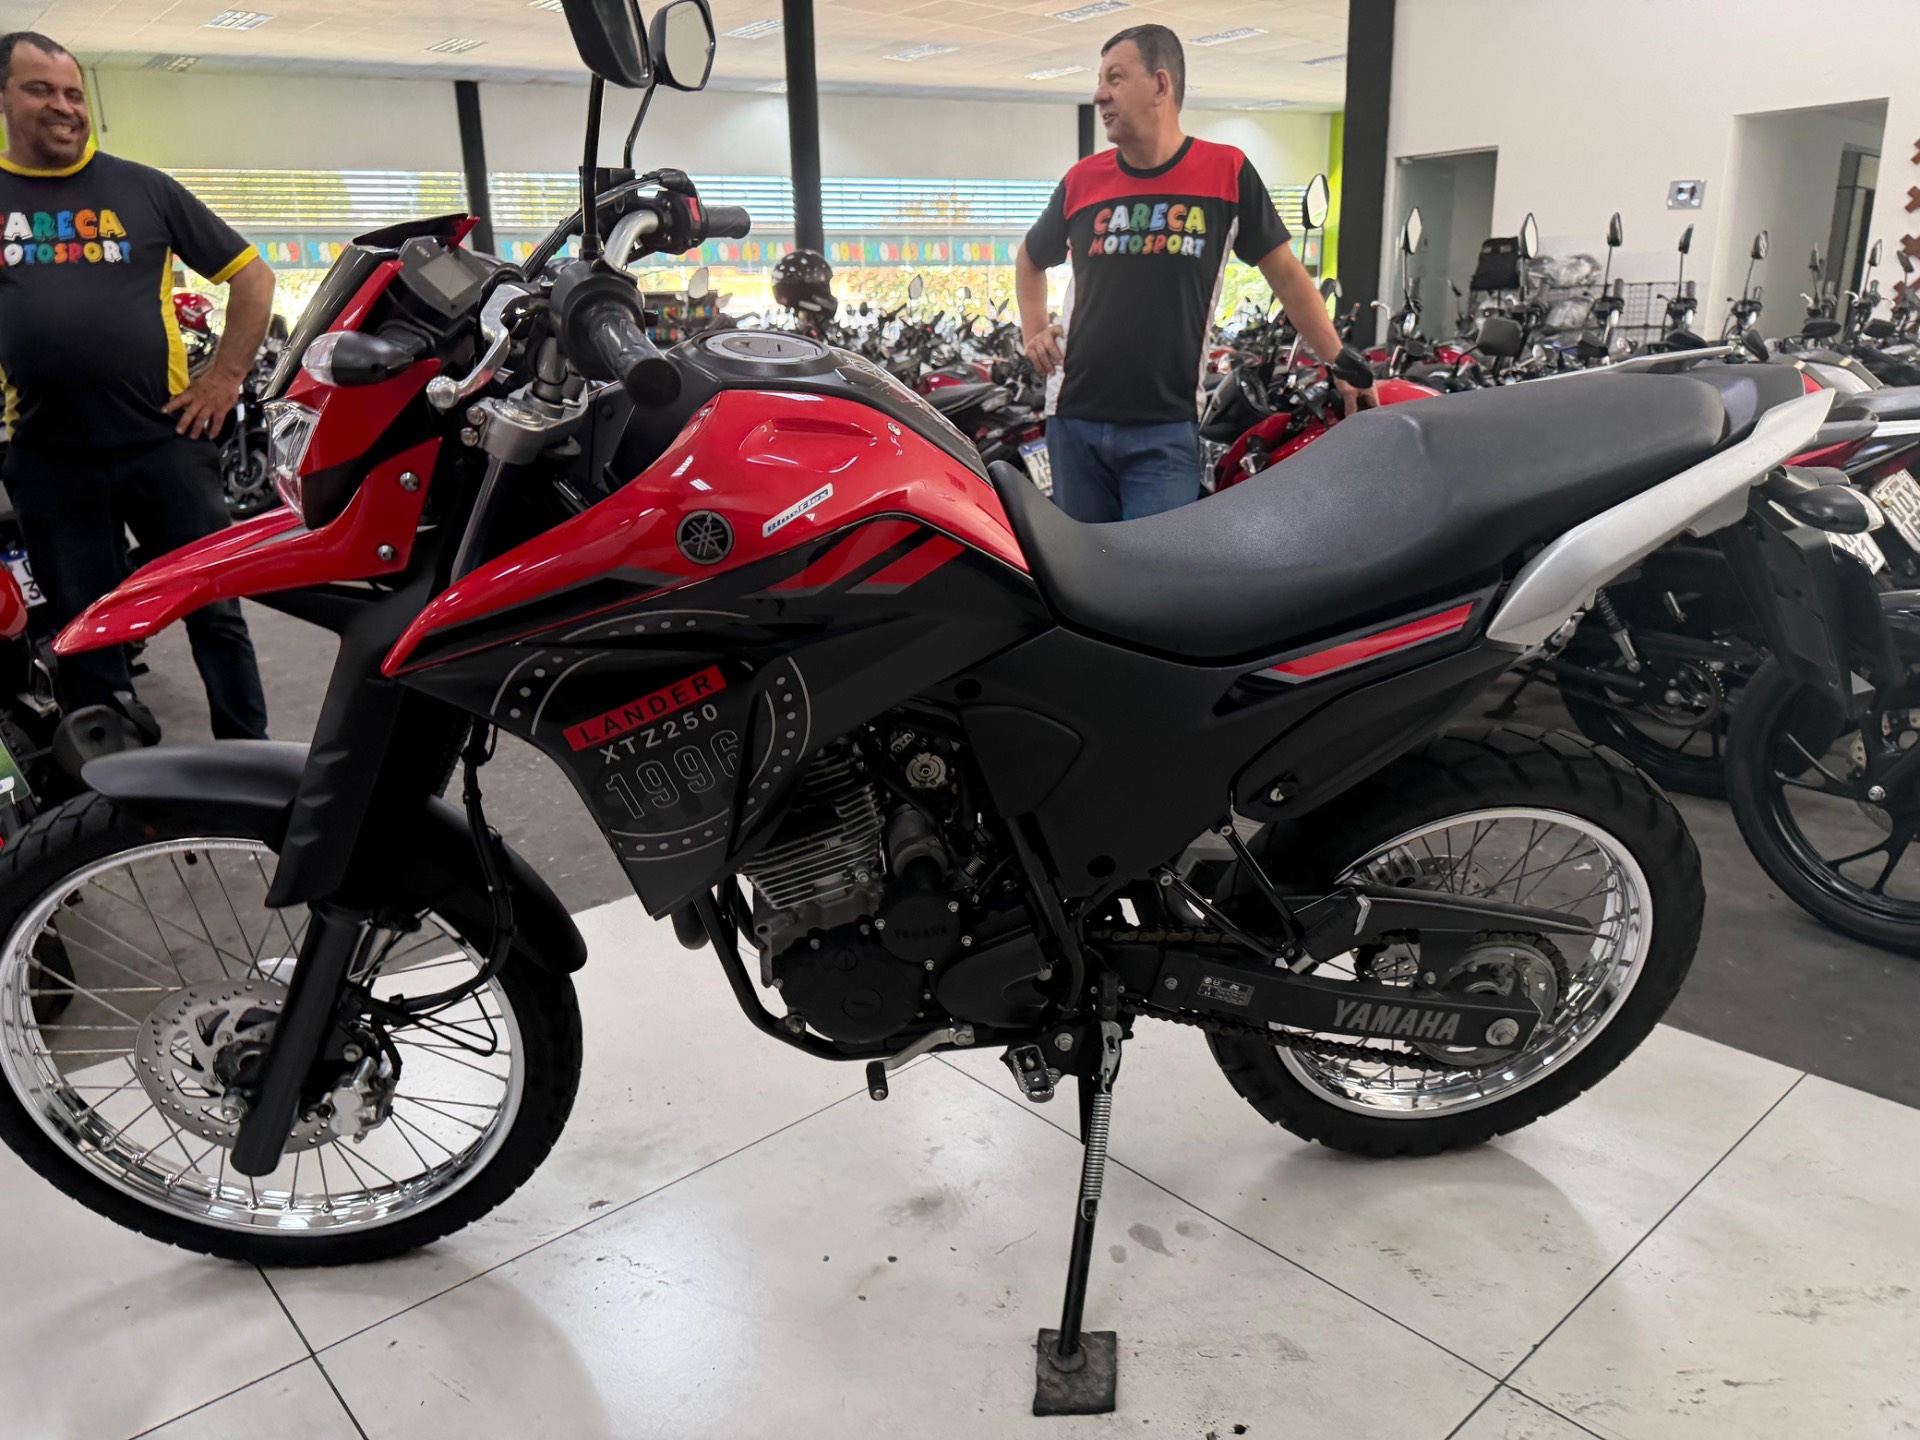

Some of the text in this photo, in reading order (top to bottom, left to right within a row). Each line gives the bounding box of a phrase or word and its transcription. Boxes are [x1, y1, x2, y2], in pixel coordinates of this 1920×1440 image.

[0, 209, 127, 241] ARECA
[1094, 203, 1206, 235] CARECA
[0, 240, 132, 266] OTOSPORT
[1088, 234, 1206, 258] MOTOSPORT
[580, 675, 713, 744] LANDER
[599, 703, 718, 764] XTZ250
[606, 729, 738, 819] 1996
[1334, 1000, 1461, 1040] YAMAHA
